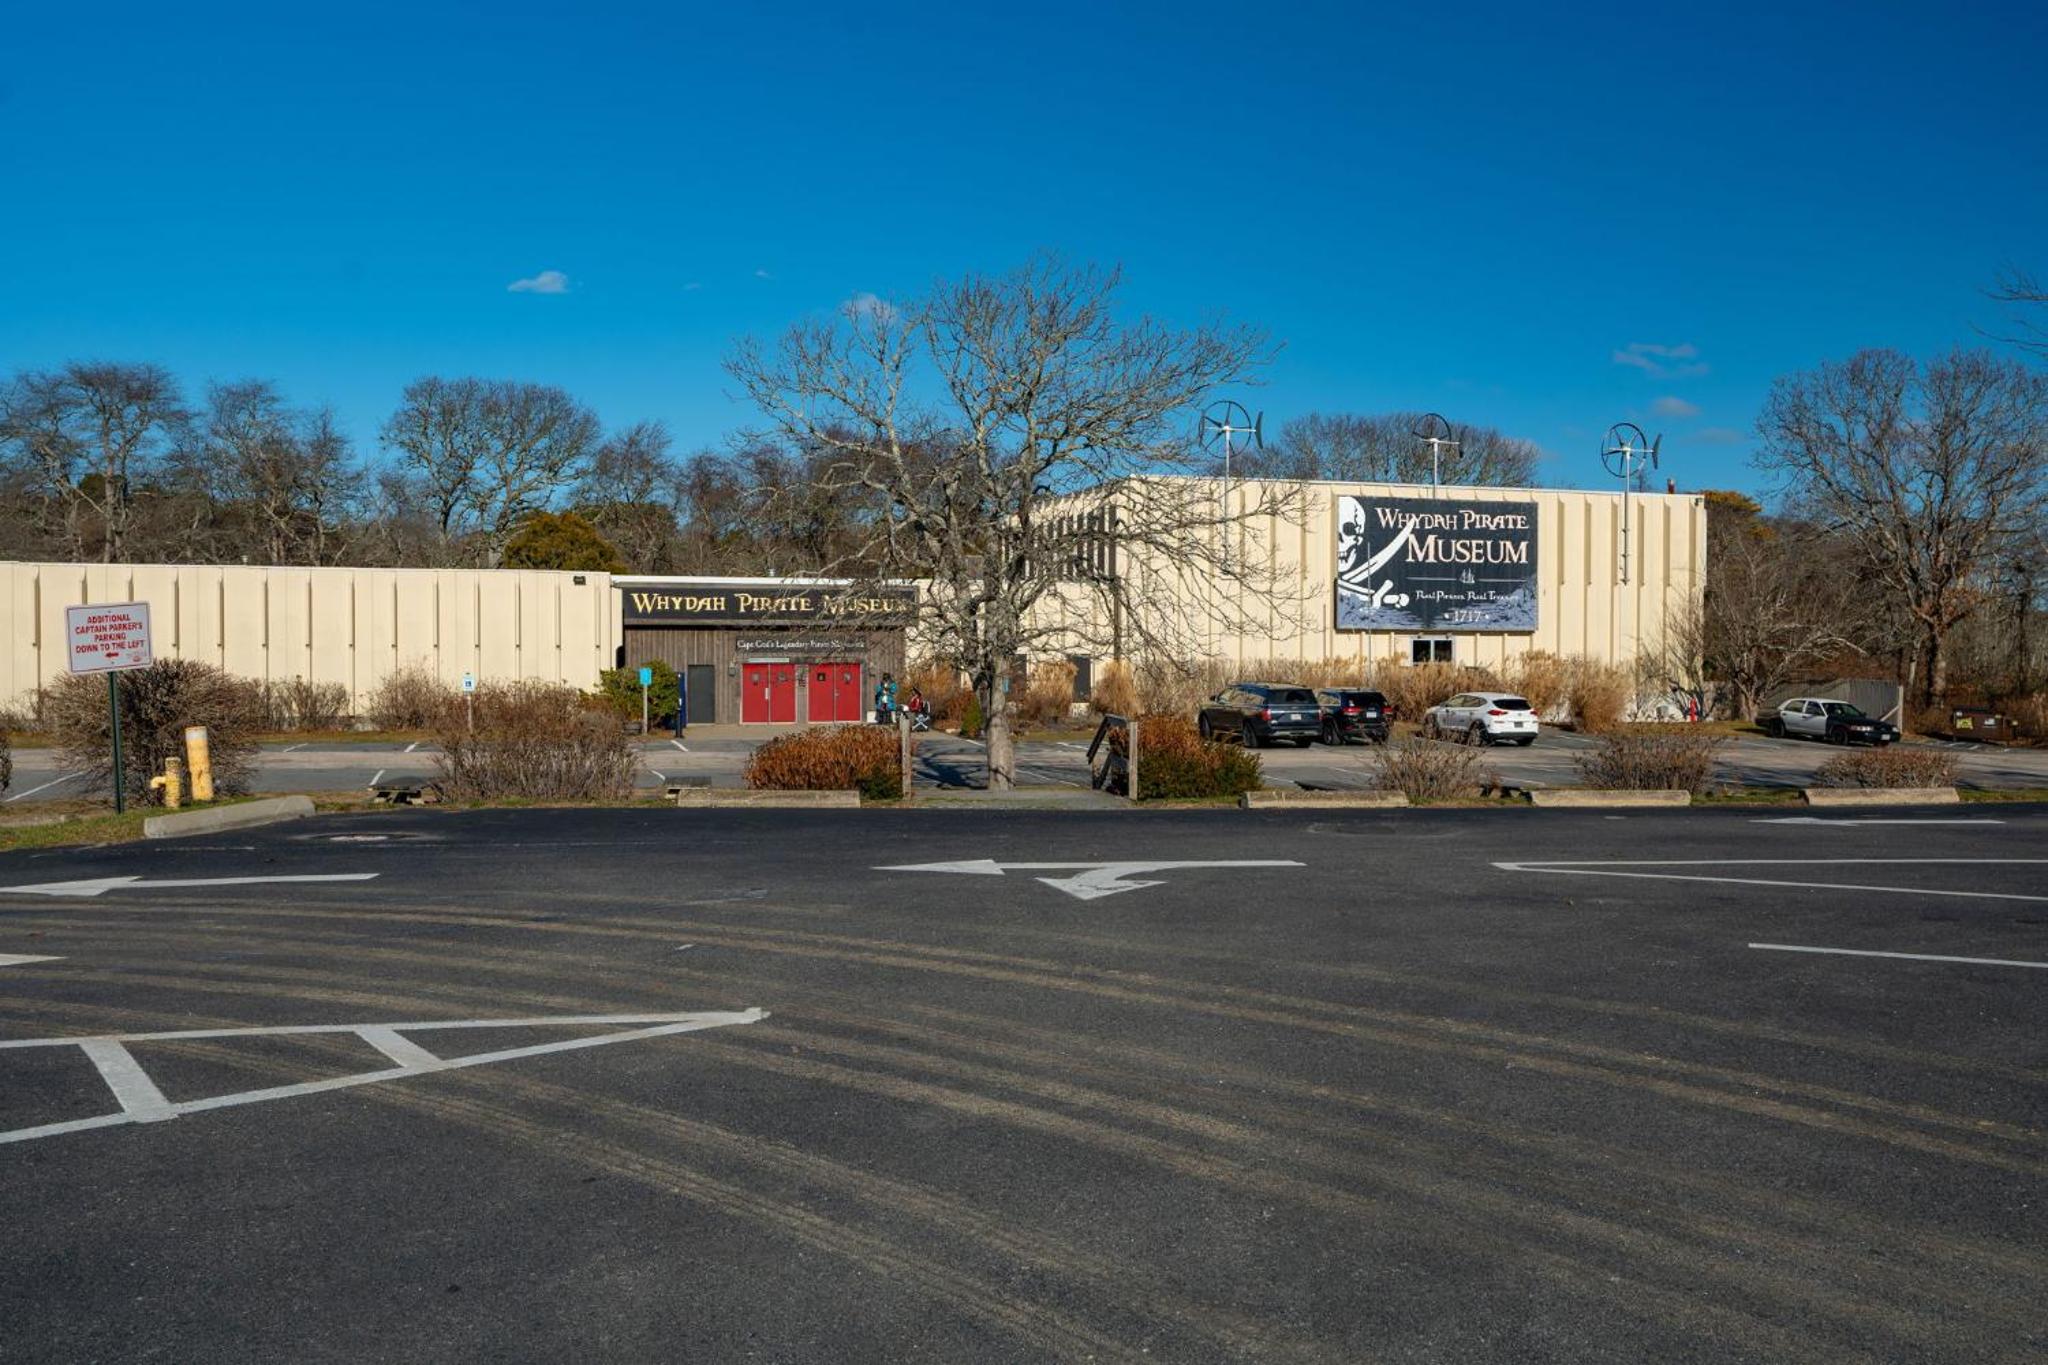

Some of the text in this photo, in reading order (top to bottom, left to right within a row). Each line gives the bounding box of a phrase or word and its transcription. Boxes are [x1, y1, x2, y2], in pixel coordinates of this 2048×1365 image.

[1459, 510, 1530, 531] PIRATE
[1405, 534, 1530, 564] MUSEUM
[630, 593, 908, 616] WHYDAH PIRATE MUSEU
[87, 614, 131, 624] ADDITIONAL
[1454, 610, 1482, 622] 1717
[75, 622, 143, 634] CAPTAIN PARKER'S
[94, 632, 126, 642] PARKING
[76, 640, 144, 653] DOWN TO THE LEFT
